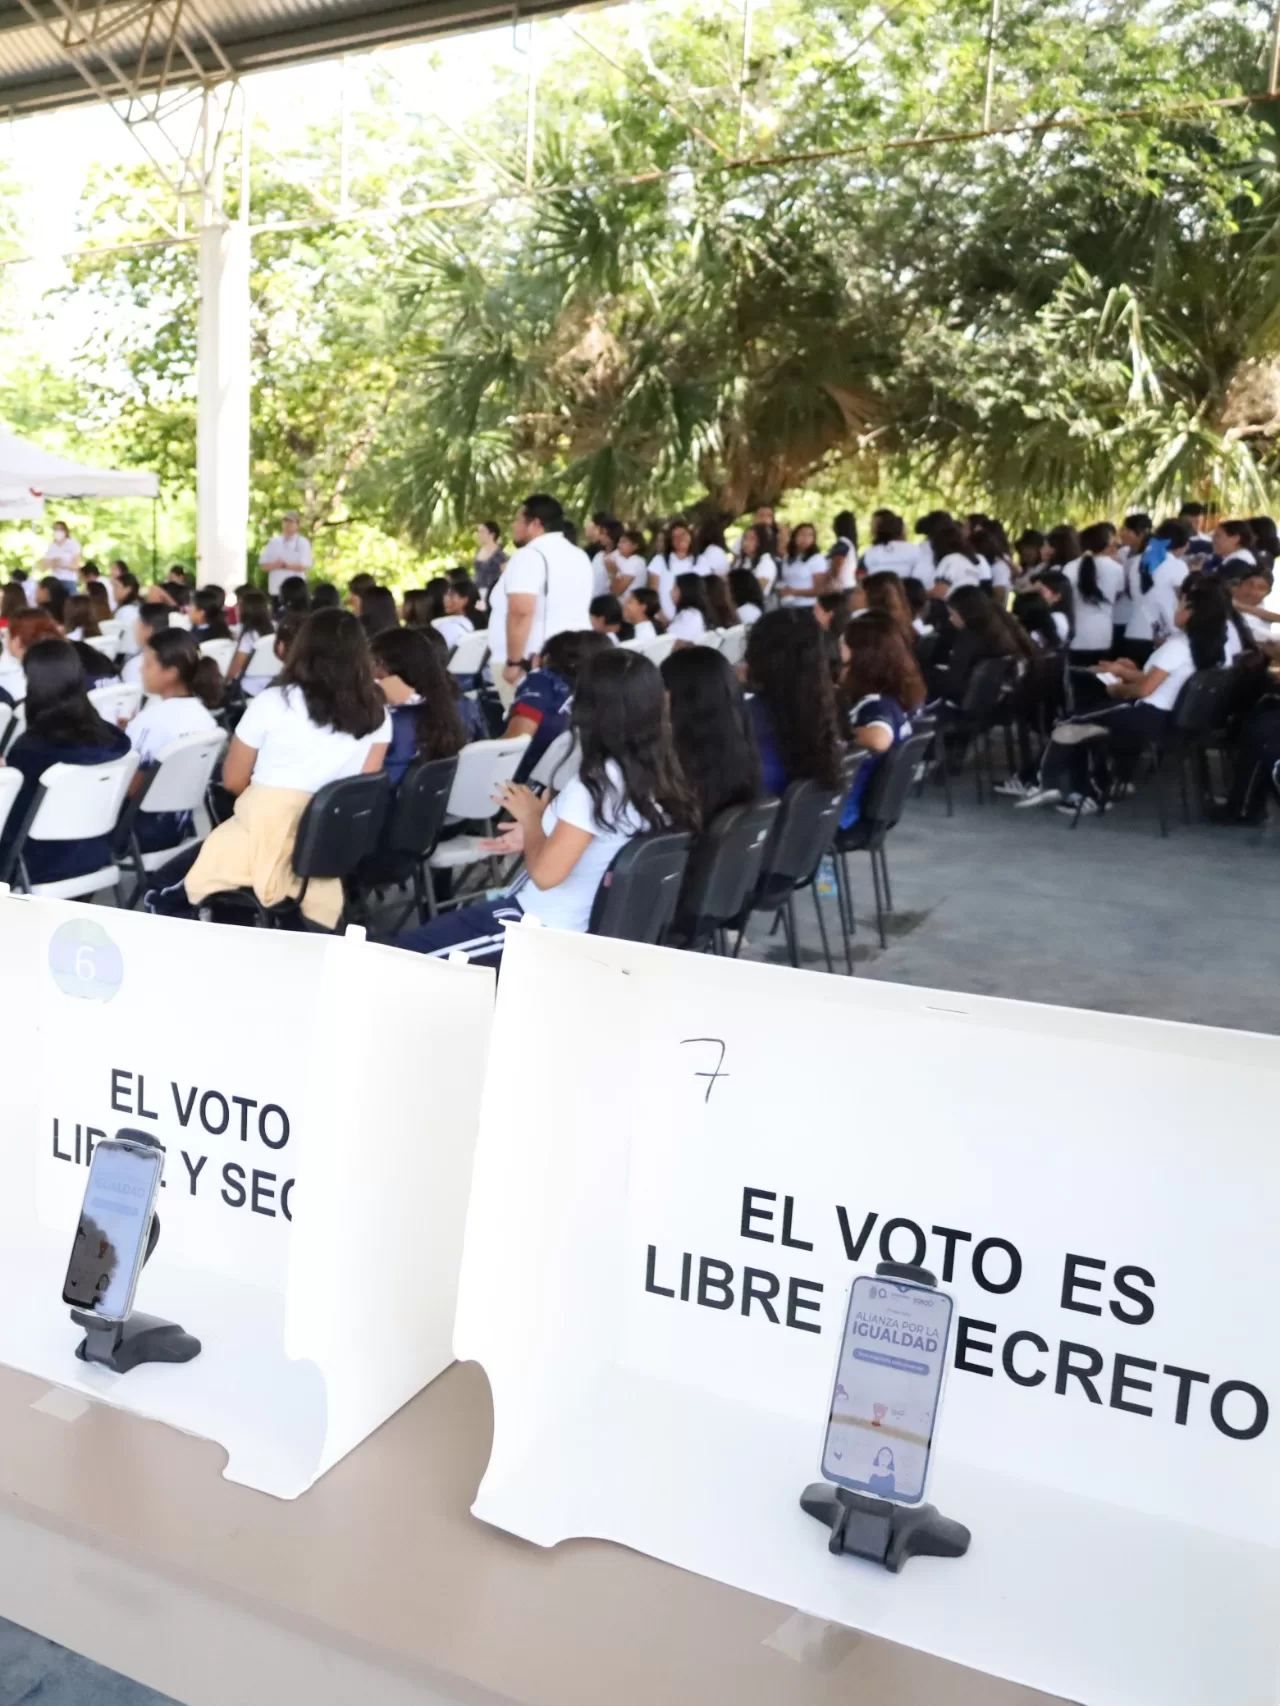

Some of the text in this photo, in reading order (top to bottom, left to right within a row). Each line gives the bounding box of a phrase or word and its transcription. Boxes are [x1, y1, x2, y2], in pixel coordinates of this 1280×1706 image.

[75, 945, 96, 981] 6
[680, 1037, 730, 1104] 7
[110, 1067, 291, 1150] EL VOTO
[180, 1150, 208, 1196] Y
[739, 1186, 1157, 1326] EL VOTO ES
[644, 1244, 1270, 1442] LIBRE ECRETO
[852, 1320, 939, 1353] IGUALDAD
[856, 1311, 899, 1329] ALIANZA
[902, 1321, 924, 1334] POR
[926, 1326, 939, 1338] LA
